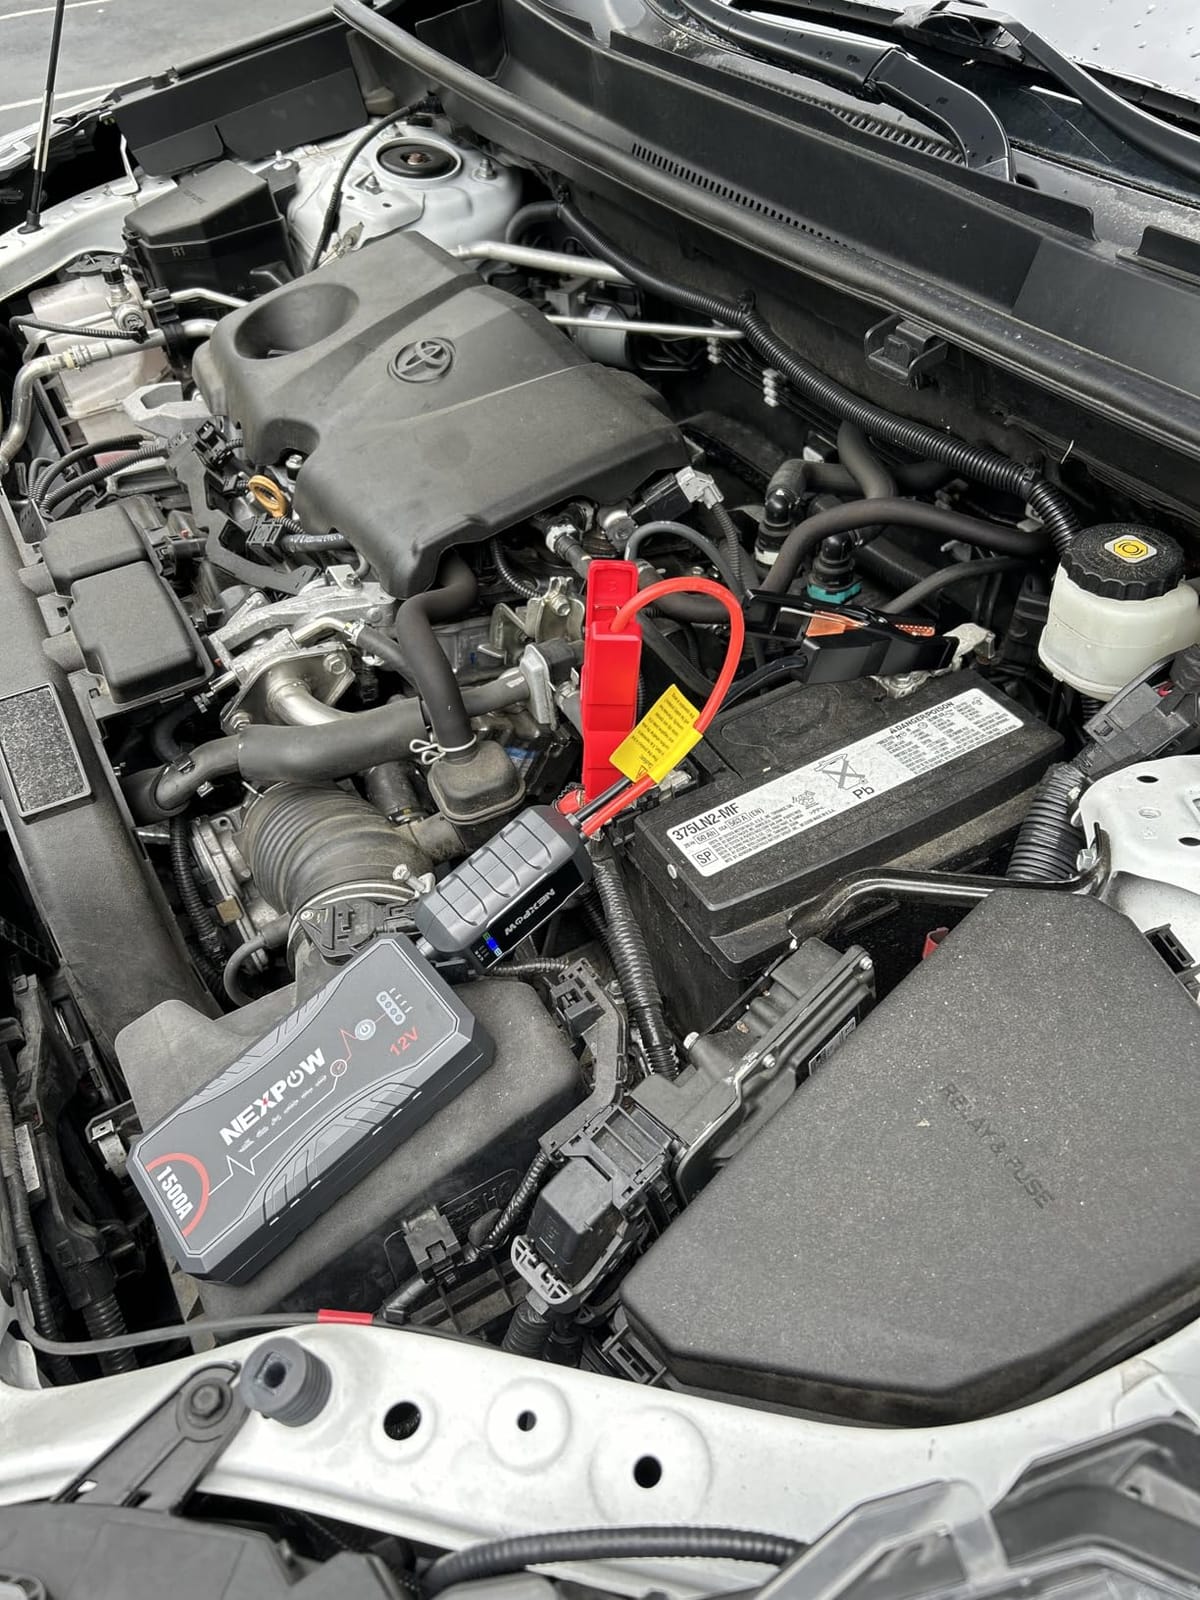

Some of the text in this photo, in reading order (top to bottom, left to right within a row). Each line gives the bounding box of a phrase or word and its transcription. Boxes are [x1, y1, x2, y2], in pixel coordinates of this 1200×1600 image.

[852, 785, 875, 799] Pb
[672, 802, 739, 840] 375LN2-MF
[696, 850, 712, 864] SP
[504, 888, 556, 936] NEXPOW
[390, 1026, 418, 1056] 12V
[219, 1047, 326, 1146] NEXPOW
[156, 1165, 194, 1221] 1500A
[1004, 1158, 1055, 1209] FUSE
